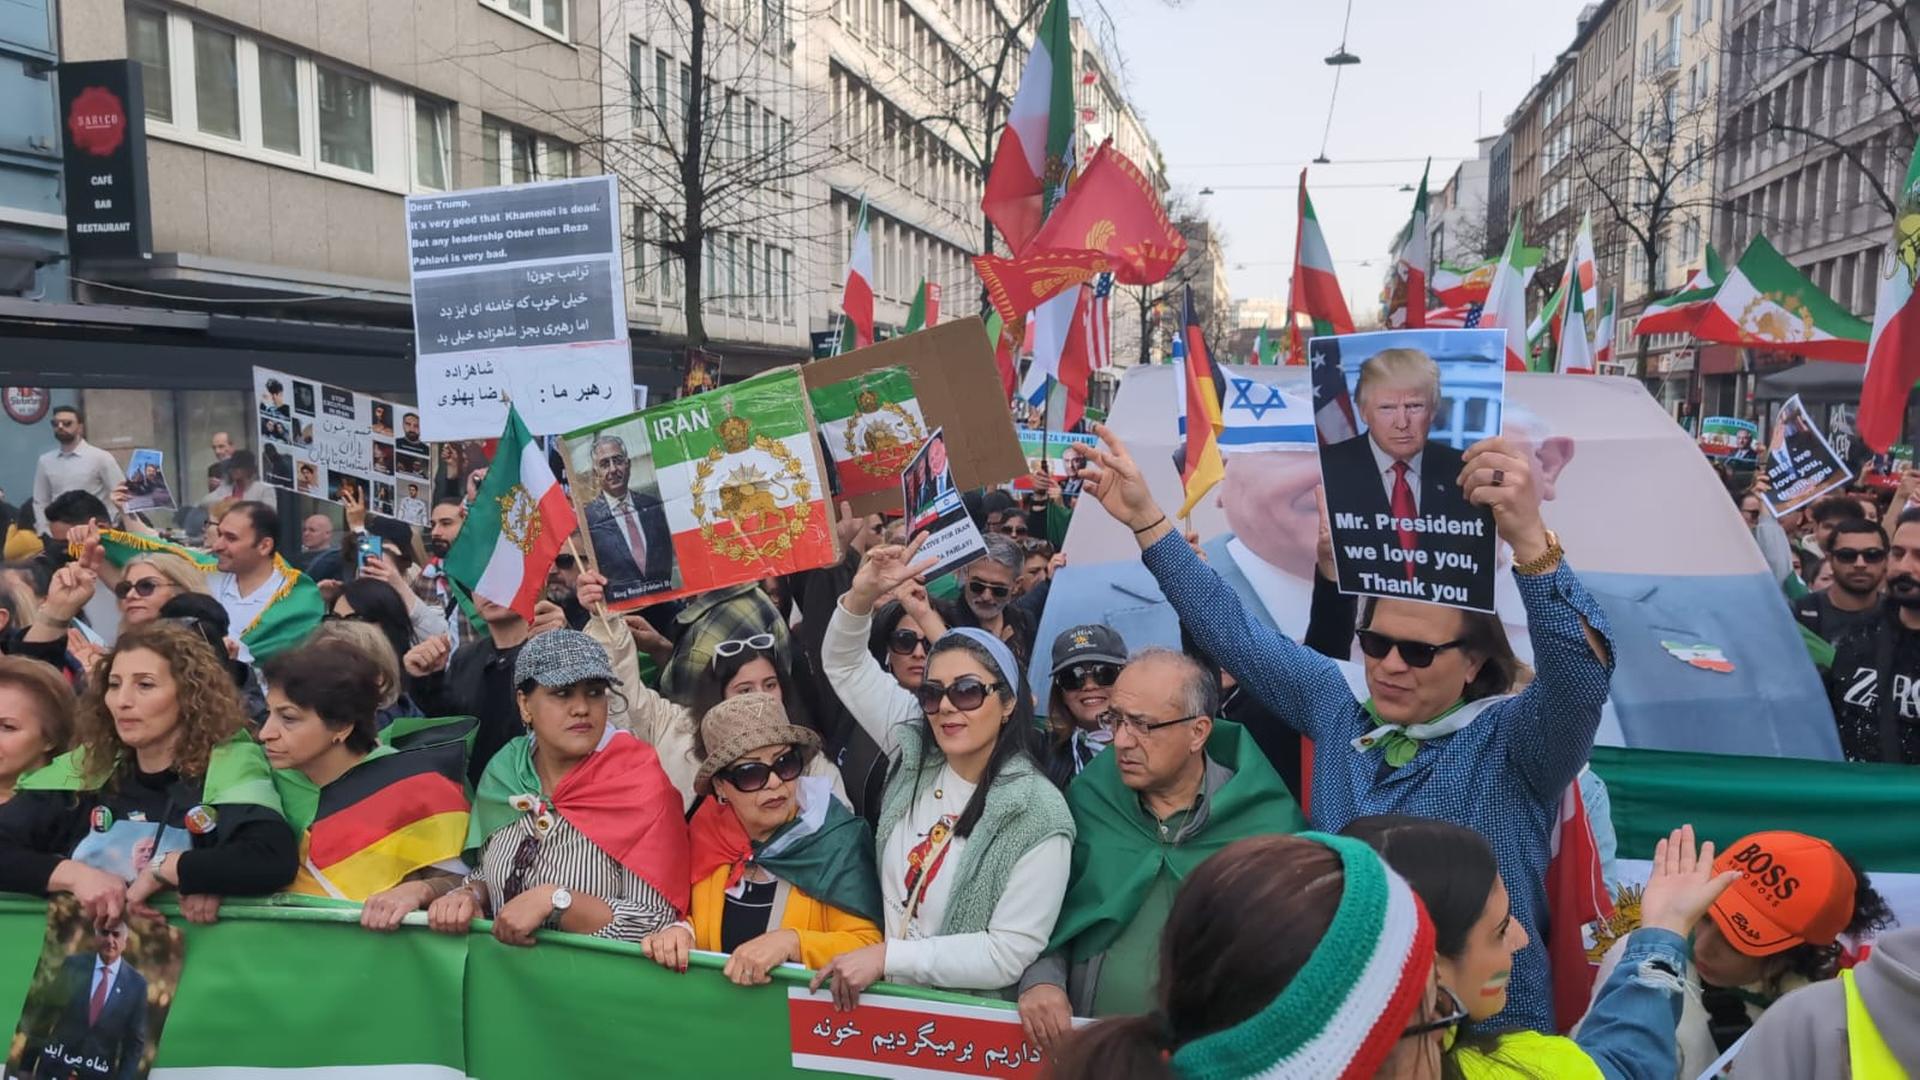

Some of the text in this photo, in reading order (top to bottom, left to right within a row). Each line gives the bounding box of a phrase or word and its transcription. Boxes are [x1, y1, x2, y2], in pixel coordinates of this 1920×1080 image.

[91, 174, 113, 186] CAFÉ
[410, 200, 471, 213] Dear Trump,
[429, 219, 450, 229] very
[453, 215, 478, 228] good
[480, 212, 501, 223] that
[504, 206, 556, 221] Khamenei
[558, 206, 568, 215] is
[570, 203, 600, 214] dead.
[76, 222, 131, 233] RESTAURANT
[412, 223, 589, 248] But any leadership Other than Reza
[413, 248, 508, 266] Pahlavi is very bad.
[557, 264, 590, 283] ترامب
[485, 299, 514, 311] خامنه
[516, 295, 531, 308] که
[531, 295, 560, 311] خوب
[561, 292, 588, 309] خیلی
[437, 318, 590, 346] اما رهبری بجز شاهزاده خیلی بد
[445, 360, 494, 380] شاهزاده
[438, 387, 475, 407] پهلوی
[552, 383, 568, 398] ما
[575, 382, 613, 402] رهبر
[652, 406, 711, 442] IRAN
[1772, 460, 1823, 490] love you,
[941, 531, 954, 542] FOR
[955, 523, 971, 536] IRAN
[1335, 512, 1485, 537] Mr. President
[1344, 544, 1479, 575] we love you,
[1358, 572, 1468, 602] Thank you
[1733, 843, 1800, 900] BOSS
[1750, 879, 1780, 908] BOSS
[812, 1017, 862, 1046] خونه
[64, 1054, 83, 1069] می
[86, 1056, 109, 1073] شاه
[983, 1041, 1042, 1070] داریم
